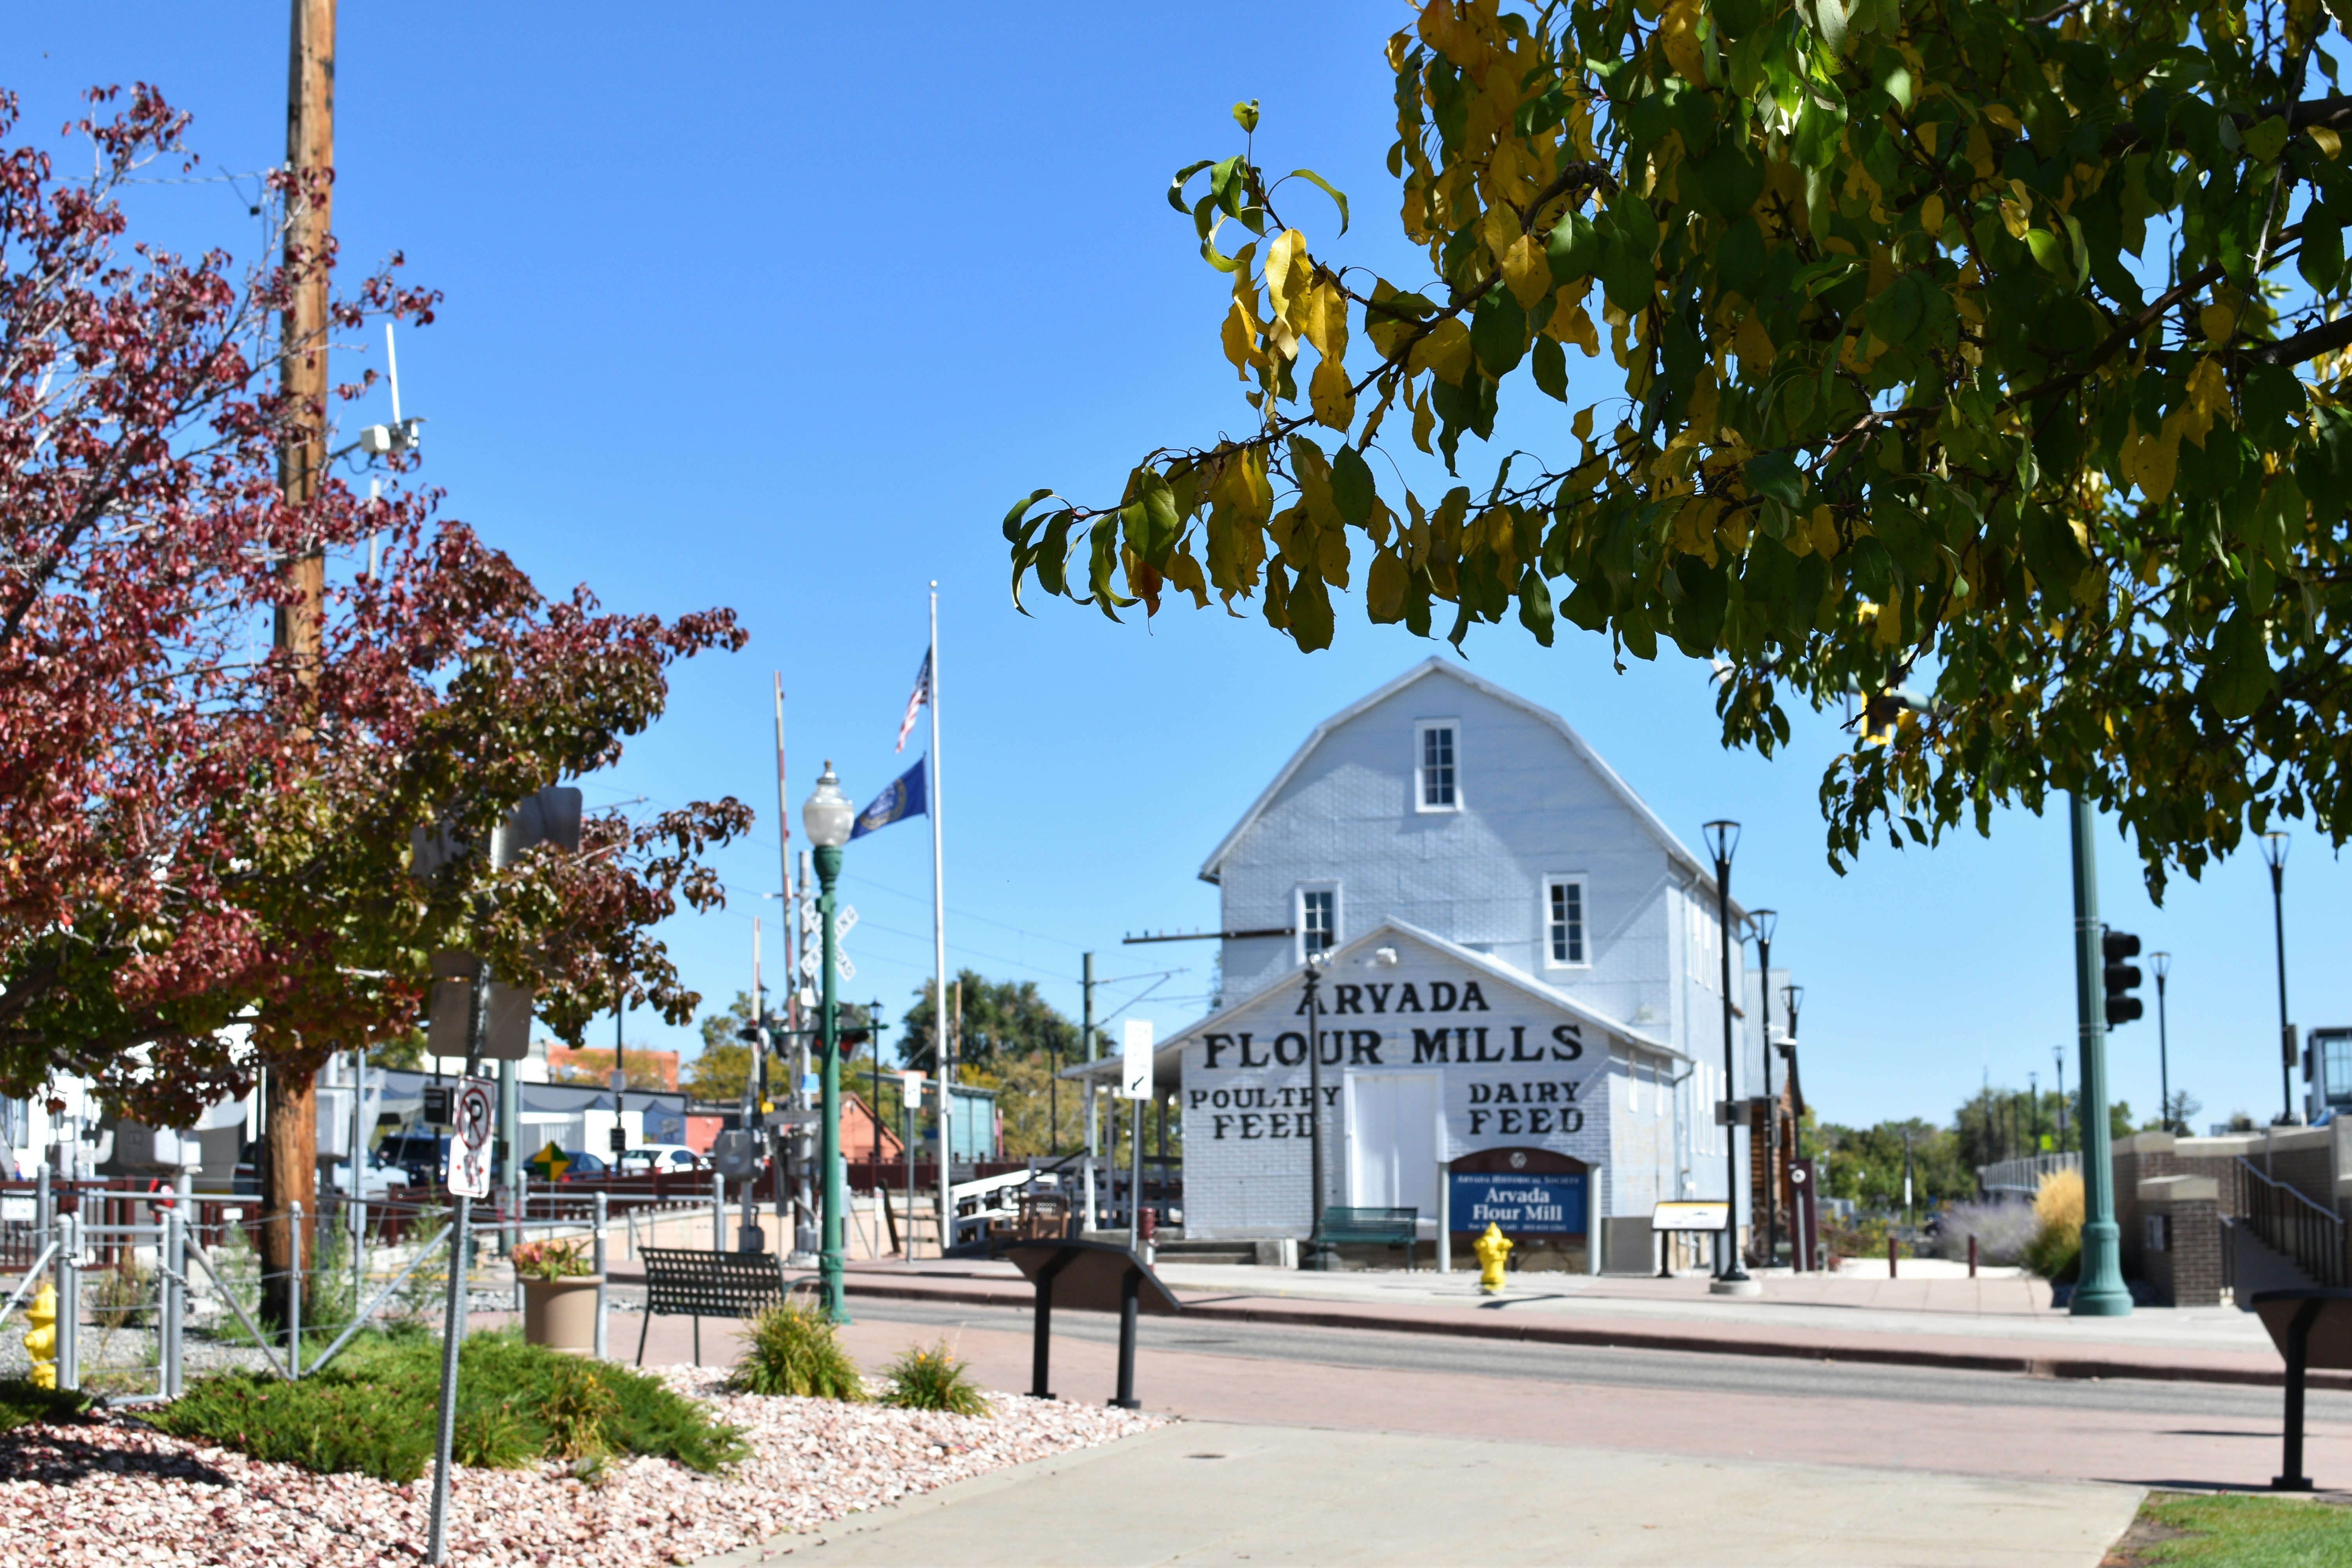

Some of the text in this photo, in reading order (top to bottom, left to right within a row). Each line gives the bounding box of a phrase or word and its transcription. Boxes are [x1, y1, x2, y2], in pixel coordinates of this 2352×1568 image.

[1296, 982, 1490, 1015] ARVADA
[1203, 1024, 1583, 1067] FLOUR MILLS
[1469, 1081, 1580, 1104] DAIRY
[1213, 1113, 1314, 1139] FEED
[1468, 1107, 1583, 1135] FEED
[1485, 1187, 1550, 1203] Arvada
[1473, 1204, 1563, 1221] Flour Mill
